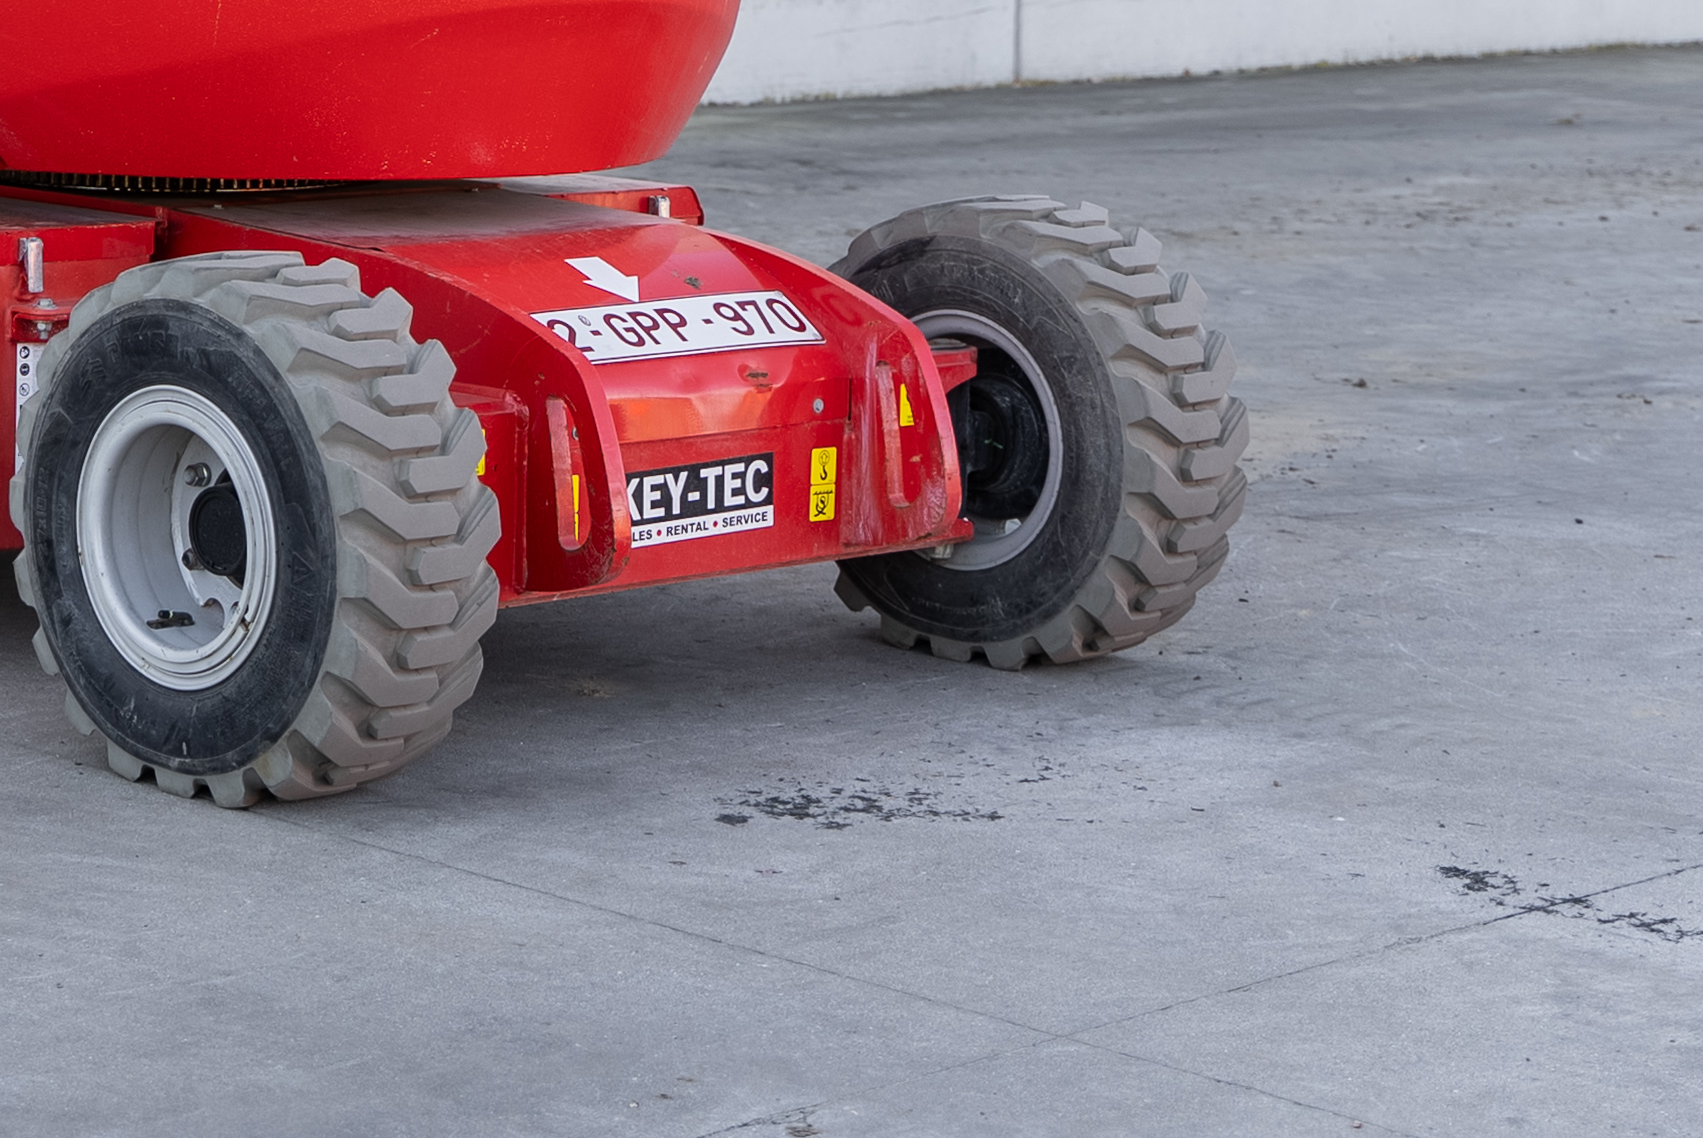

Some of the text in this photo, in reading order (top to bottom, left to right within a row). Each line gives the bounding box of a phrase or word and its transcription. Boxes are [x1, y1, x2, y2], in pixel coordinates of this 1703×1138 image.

[627, 459, 769, 521] KEY-TEC
[632, 511, 768, 542] LES RENTAL SERVICE
